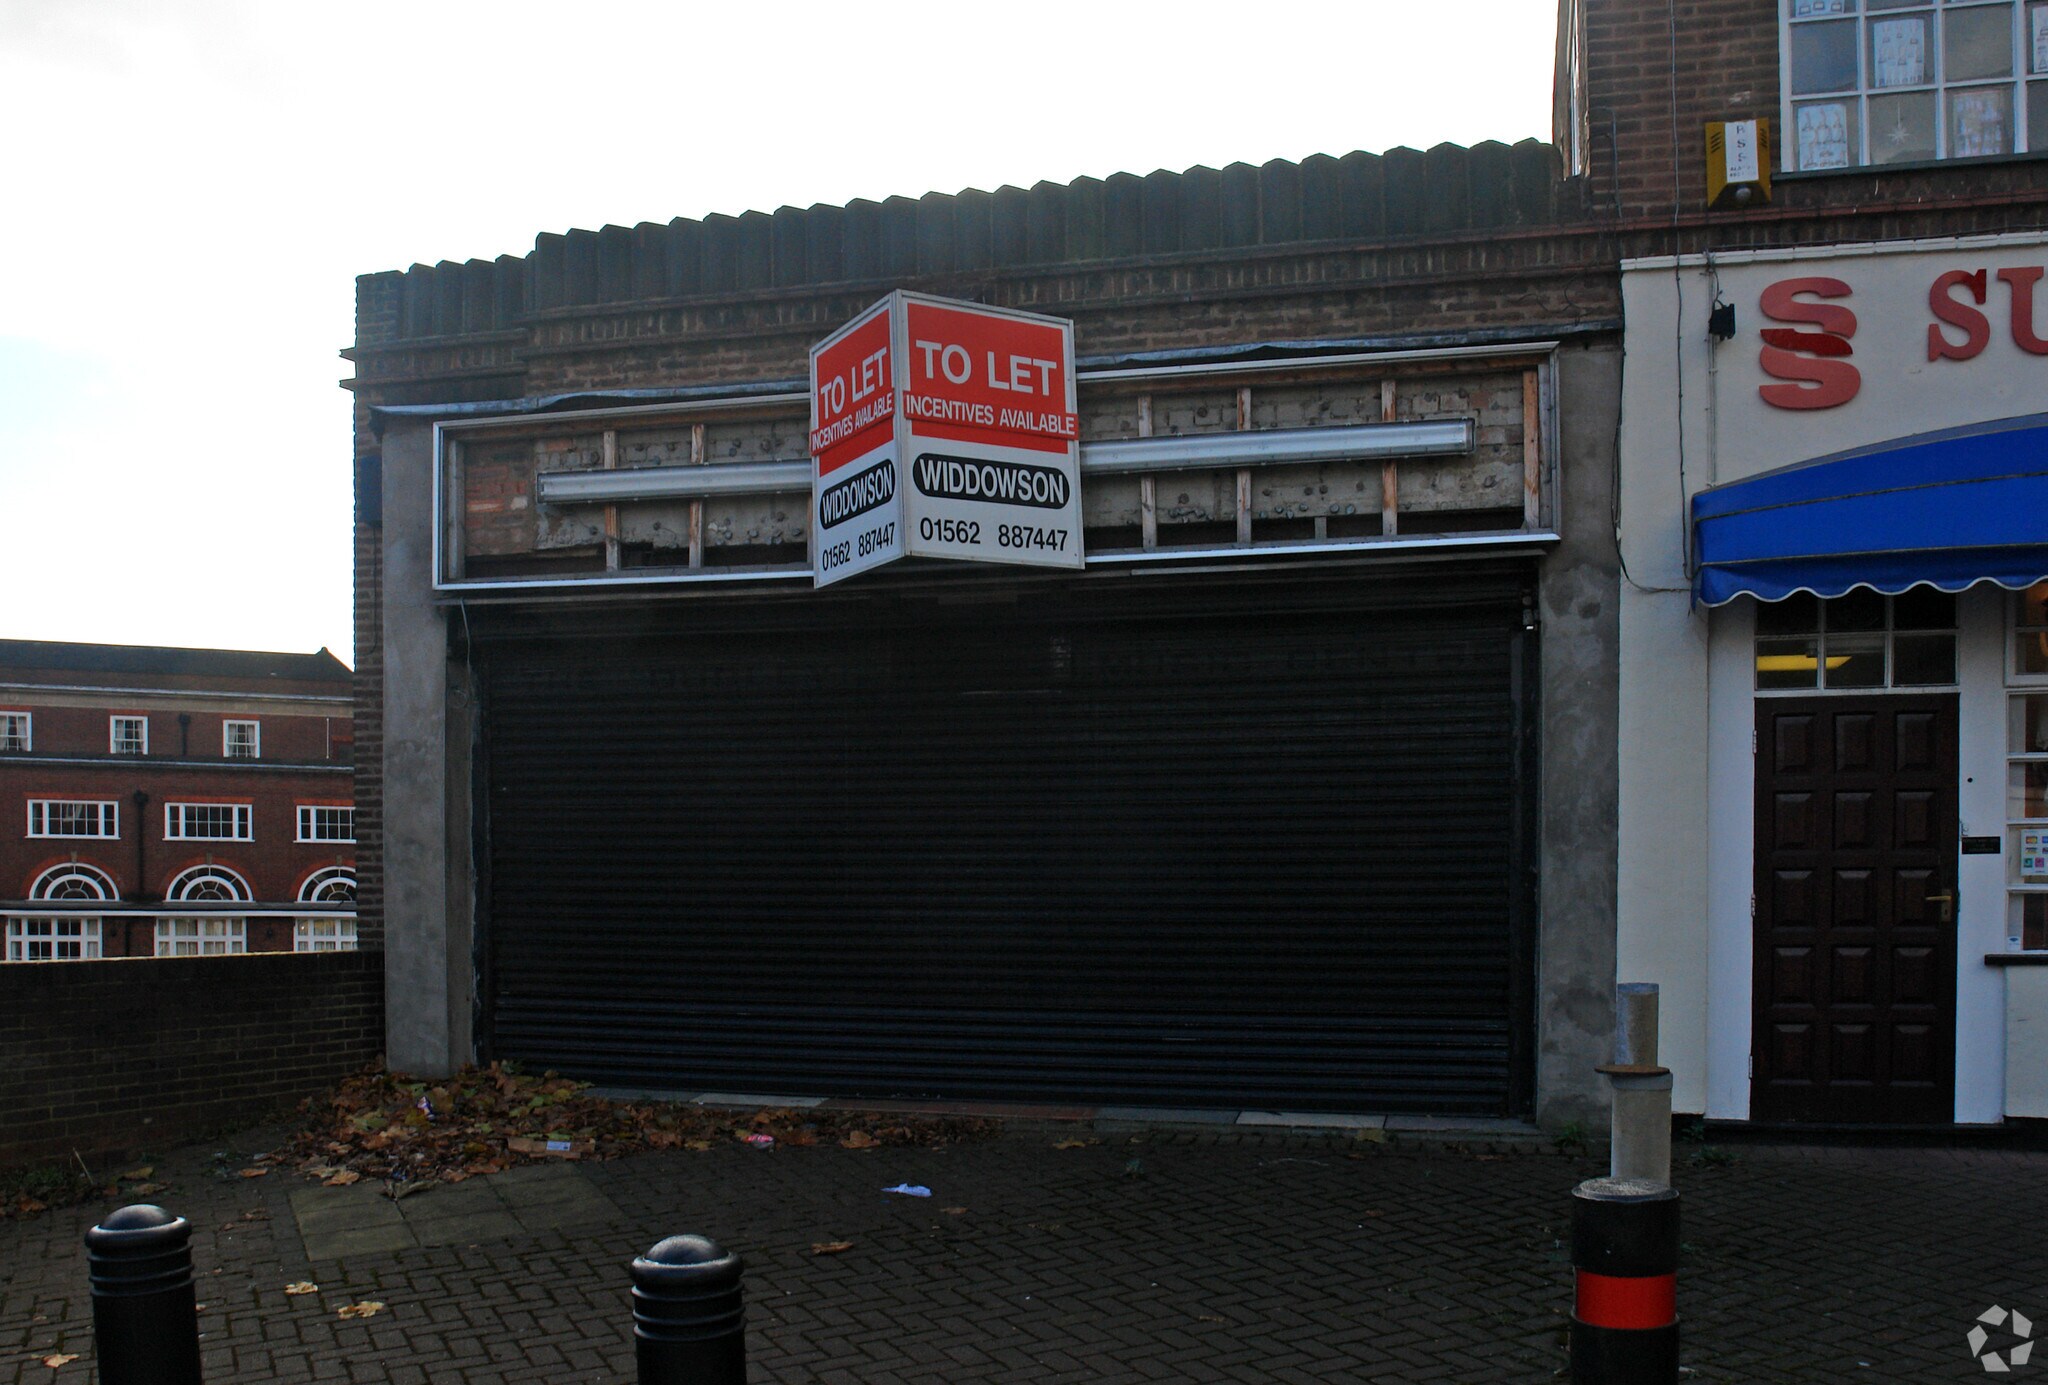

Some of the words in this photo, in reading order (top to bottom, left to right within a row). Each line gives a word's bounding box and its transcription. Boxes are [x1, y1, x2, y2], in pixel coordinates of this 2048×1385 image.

[820, 375, 845, 420] TO
[851, 346, 887, 403] LET
[916, 340, 972, 385] TO
[987, 351, 1057, 396] LET
[811, 414, 853, 452] INCENTIVES
[855, 392, 893, 431] AVAILABLE
[906, 394, 994, 425] INCENTIVES
[999, 407, 1075, 435] AVAILABLE
[822, 464, 892, 524] WIDDOWSON
[919, 459, 1064, 504] WIDDOWSON
[822, 541, 851, 571] 01562
[858, 522, 895, 557] 887447
[920, 517, 981, 544] 01562
[998, 524, 1068, 551] 887447
